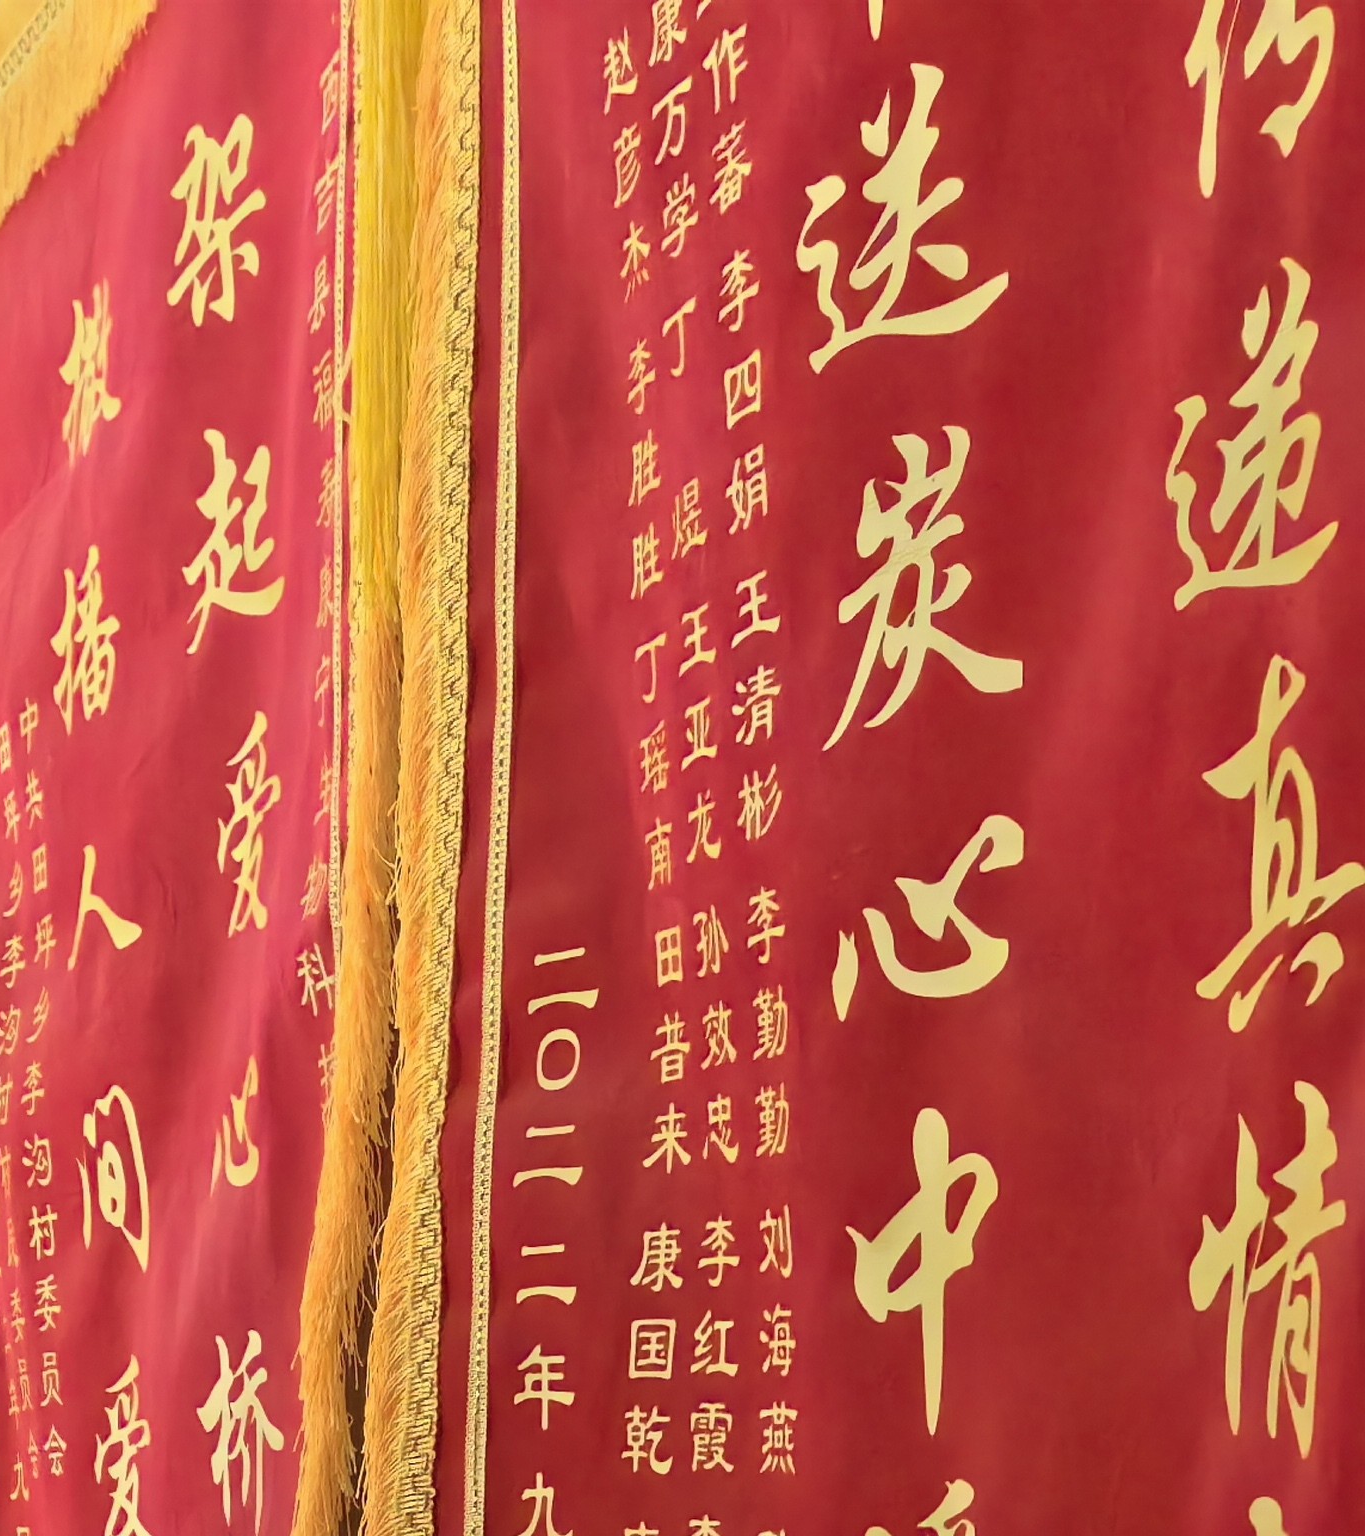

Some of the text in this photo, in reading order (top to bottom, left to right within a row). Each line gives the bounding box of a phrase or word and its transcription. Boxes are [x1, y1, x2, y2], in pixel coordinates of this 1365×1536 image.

[602, 26, 652, 304] 赵彦杰
[626, 337, 665, 601] 李胜胜
[719, 249, 769, 536] 李四娟
[678, 601, 722, 864] 王亚龙
[730, 569, 783, 842] 王清彬
[19, 697, 67, 1477] 中共田坪乡李沟村委员会
[692, 903, 740, 1165] 孙效忠
[746, 884, 790, 1159] 李勤勤
[620, 1220, 685, 1476] 康国乾
[689, 1212, 741, 1474] 李红霞
[758, 1202, 799, 1476] 刘海燕
